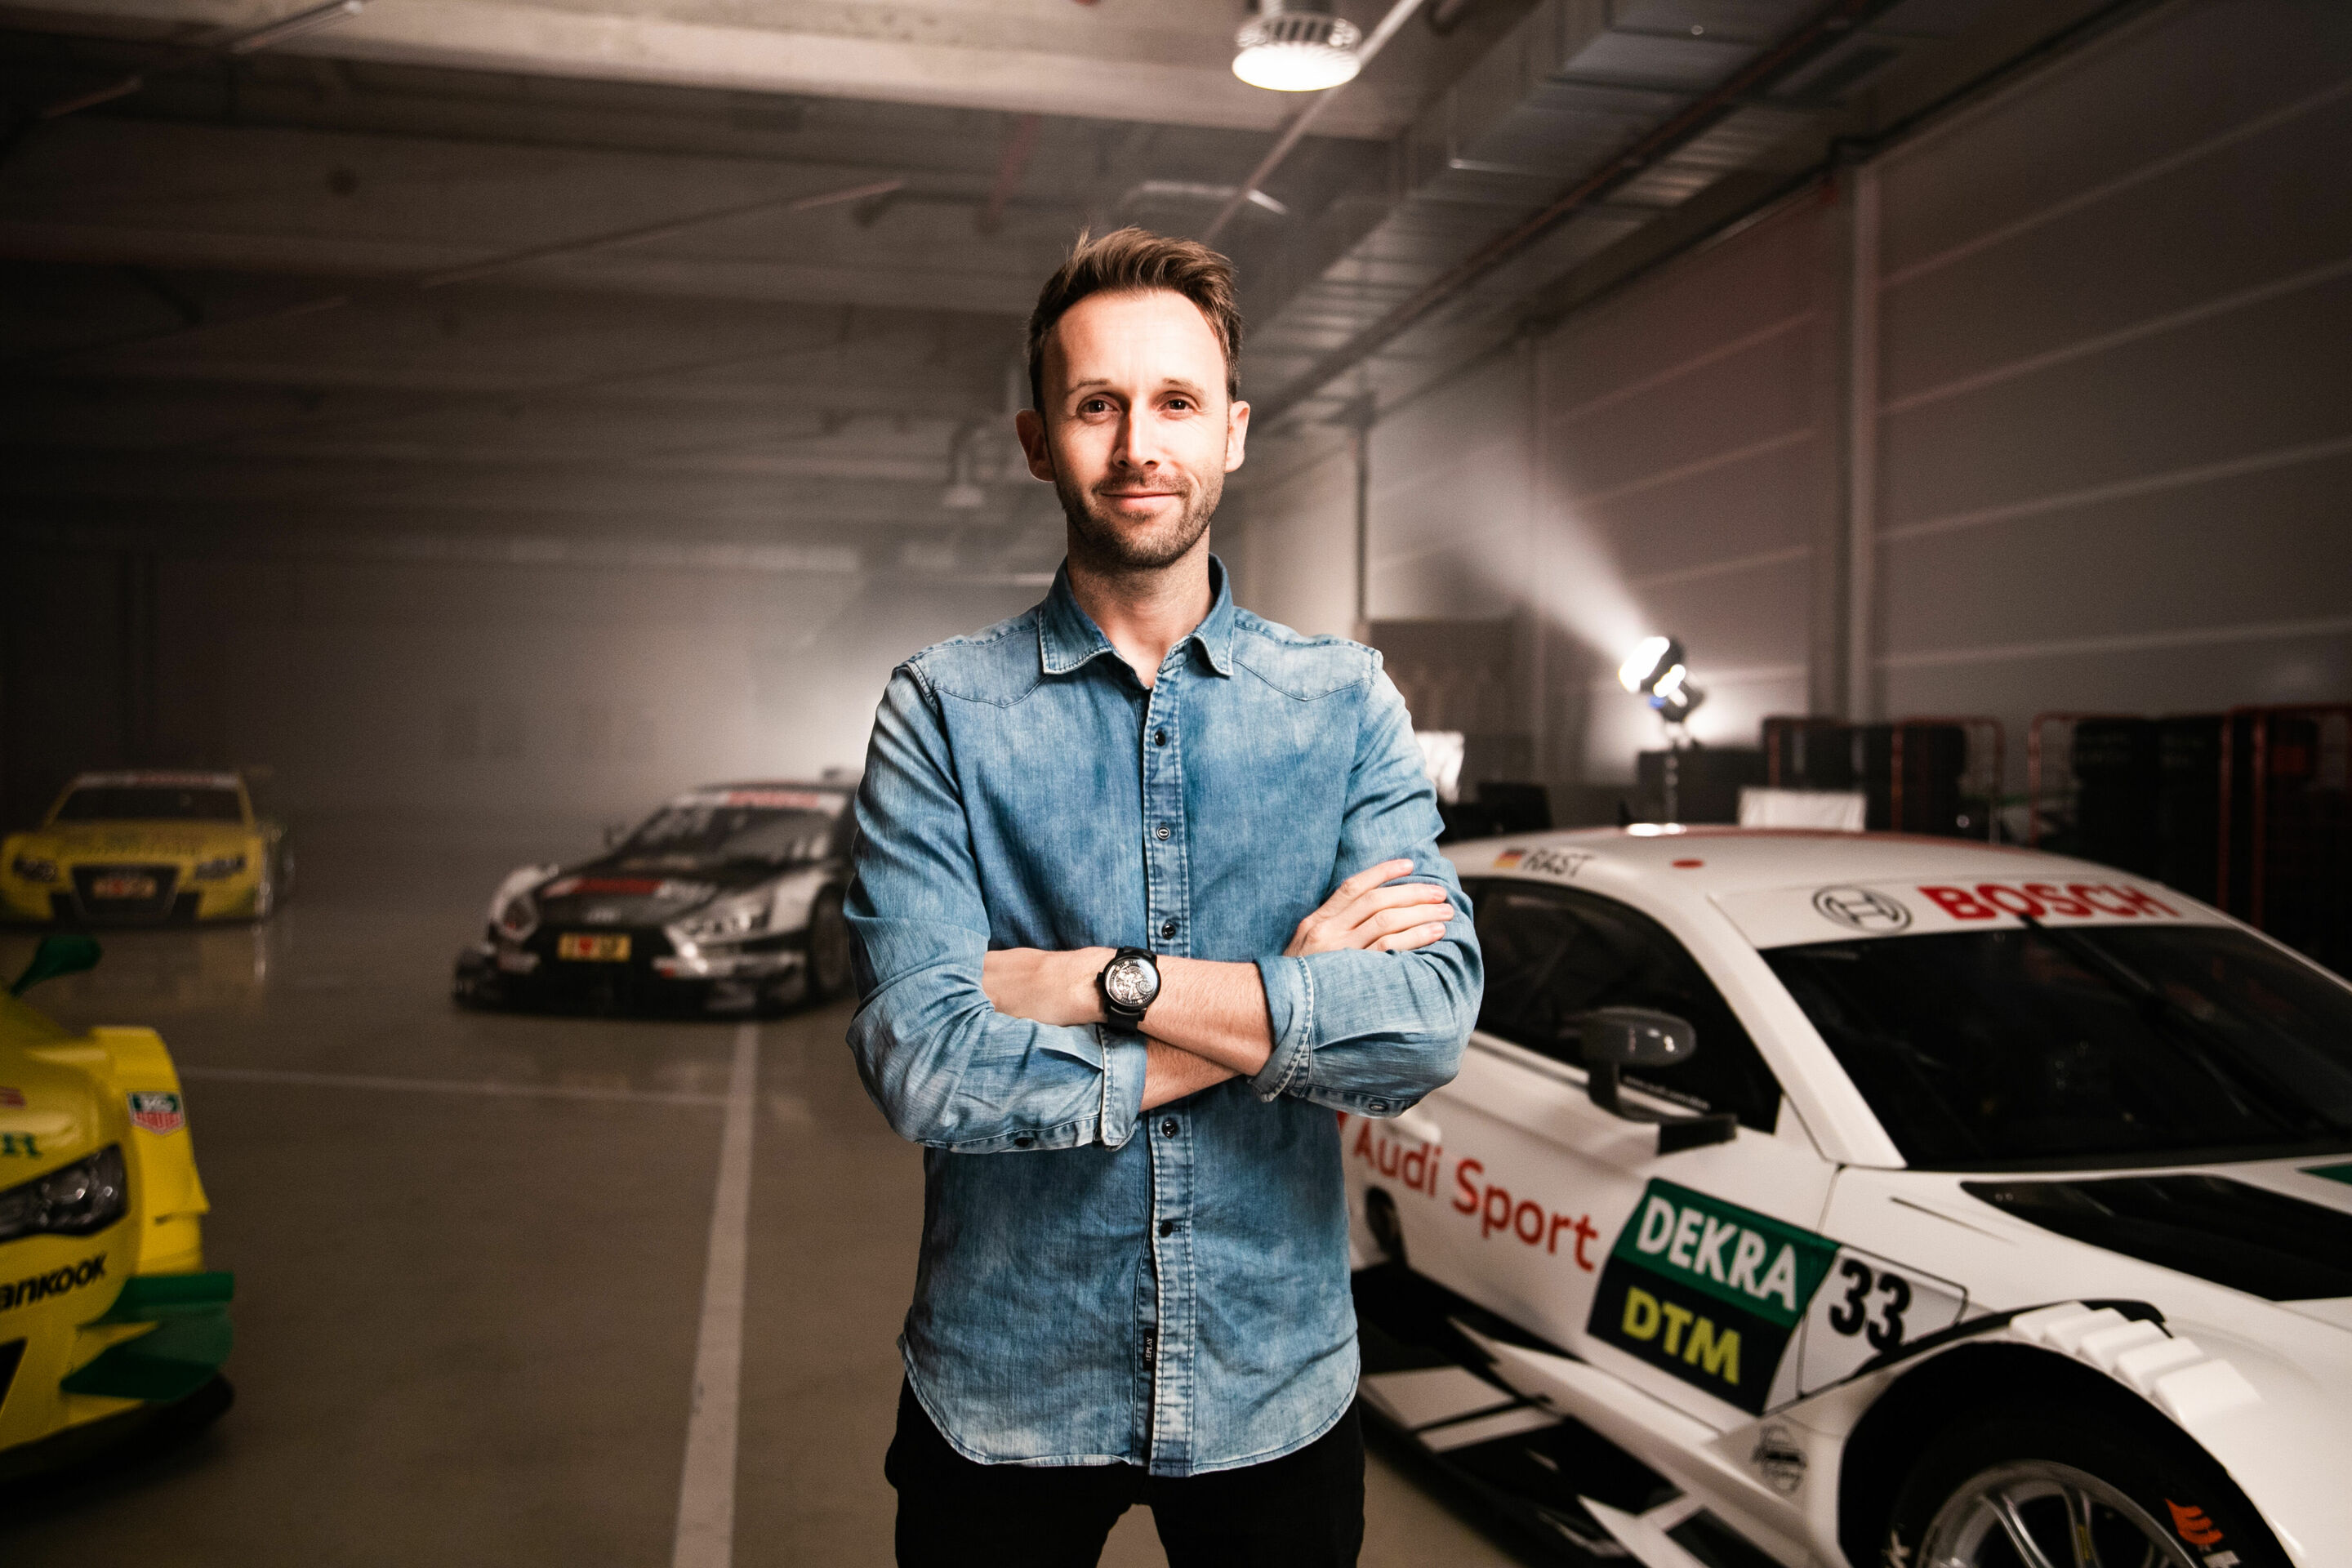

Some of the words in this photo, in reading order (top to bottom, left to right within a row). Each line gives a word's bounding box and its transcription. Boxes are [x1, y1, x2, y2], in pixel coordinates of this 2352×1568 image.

[1521, 849, 1595, 878] RAST
[1917, 882, 2182, 920] BOSCH
[1352, 1119, 1443, 1198] Audi
[1451, 1157, 1599, 1272] Sport
[1636, 1194, 1797, 1312] DEKRA
[1622, 1286, 1742, 1386] DTM
[1829, 1258, 1911, 1352] 33
